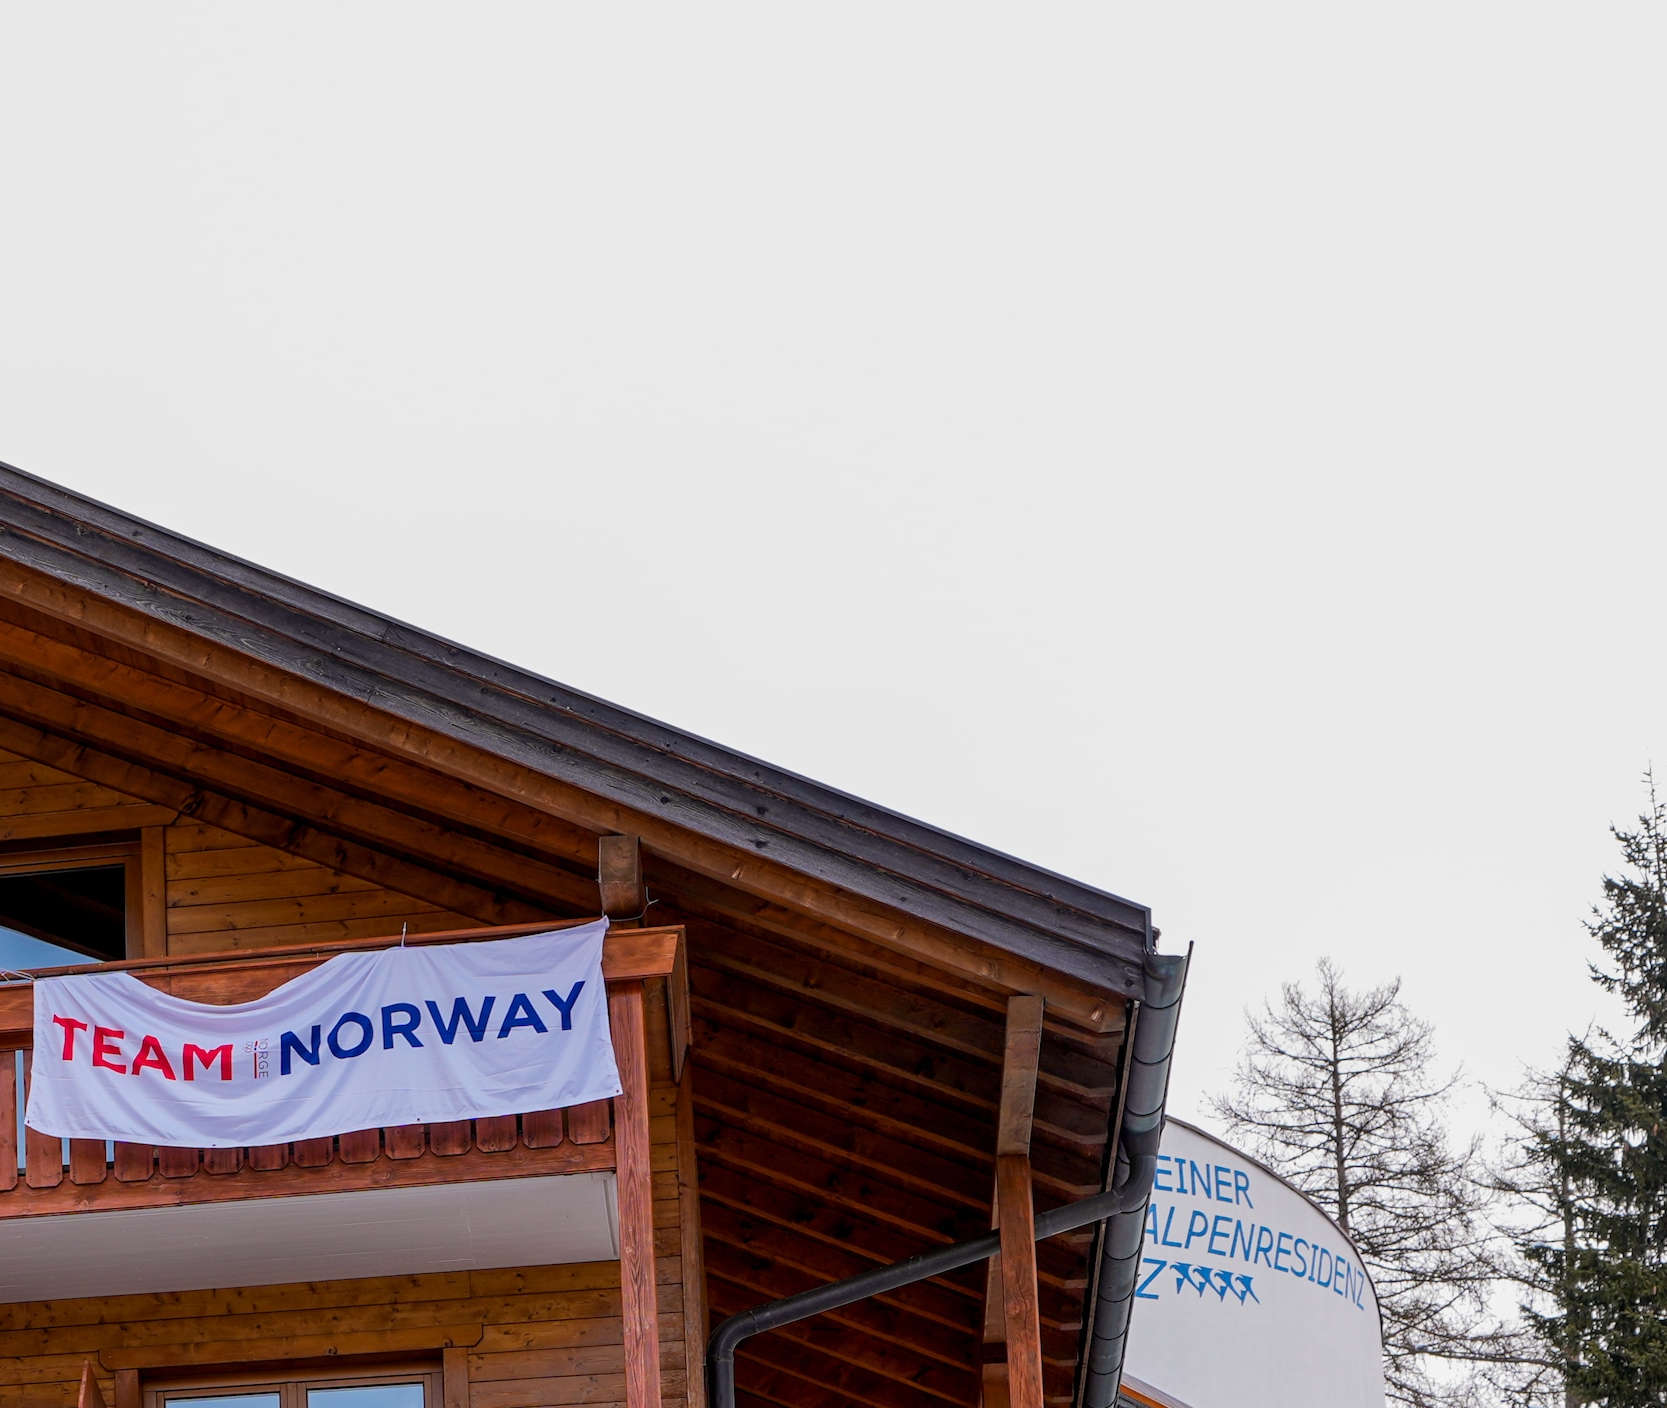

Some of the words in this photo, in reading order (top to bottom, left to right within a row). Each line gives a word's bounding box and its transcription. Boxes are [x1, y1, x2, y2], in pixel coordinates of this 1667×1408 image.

[52, 1013, 234, 1082] TEAM
[280, 980, 586, 1076] NORWAY
[1153, 1154, 1255, 1210] EINER
[1134, 1257, 1168, 1301] Z
[1144, 1203, 1365, 1312] ALPENRESIDENZ
